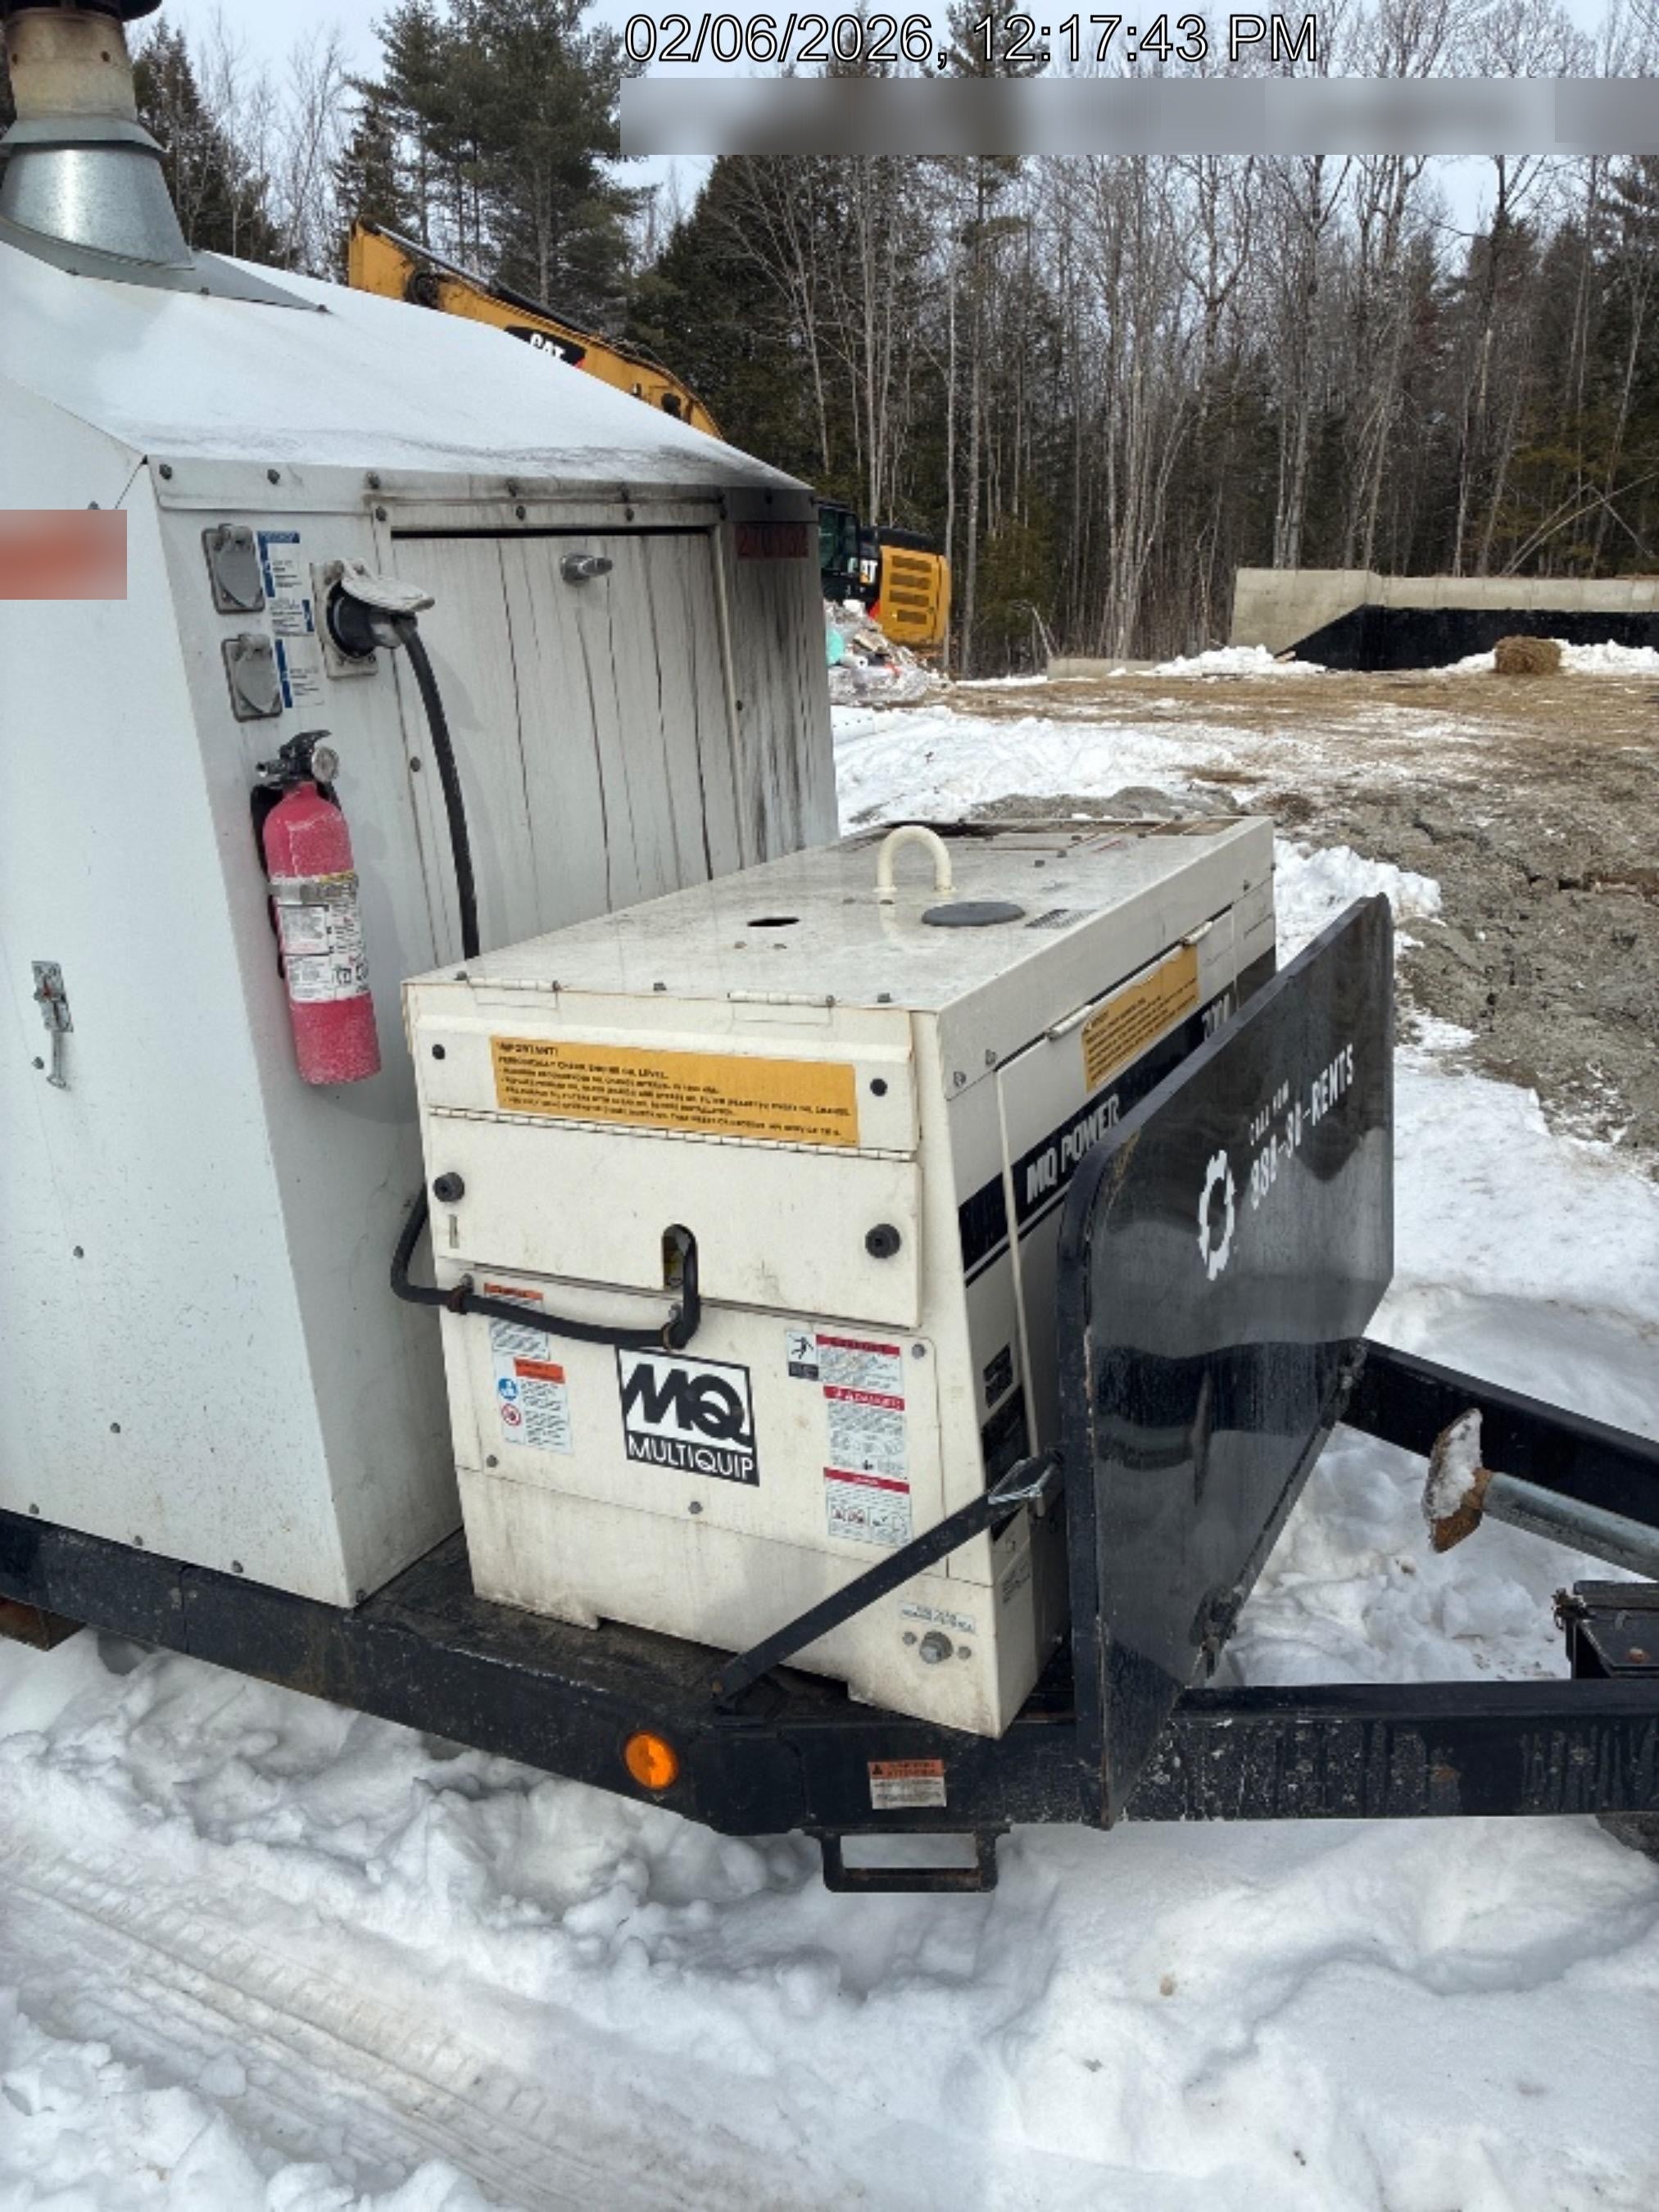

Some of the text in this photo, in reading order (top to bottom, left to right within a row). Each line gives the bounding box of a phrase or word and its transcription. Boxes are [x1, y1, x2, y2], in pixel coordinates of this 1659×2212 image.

[1027, 1093, 1119, 1206] MQ POWER
[621, 1363, 752, 1449] MQ
[628, 1435, 754, 1480] MULTIQUIP
